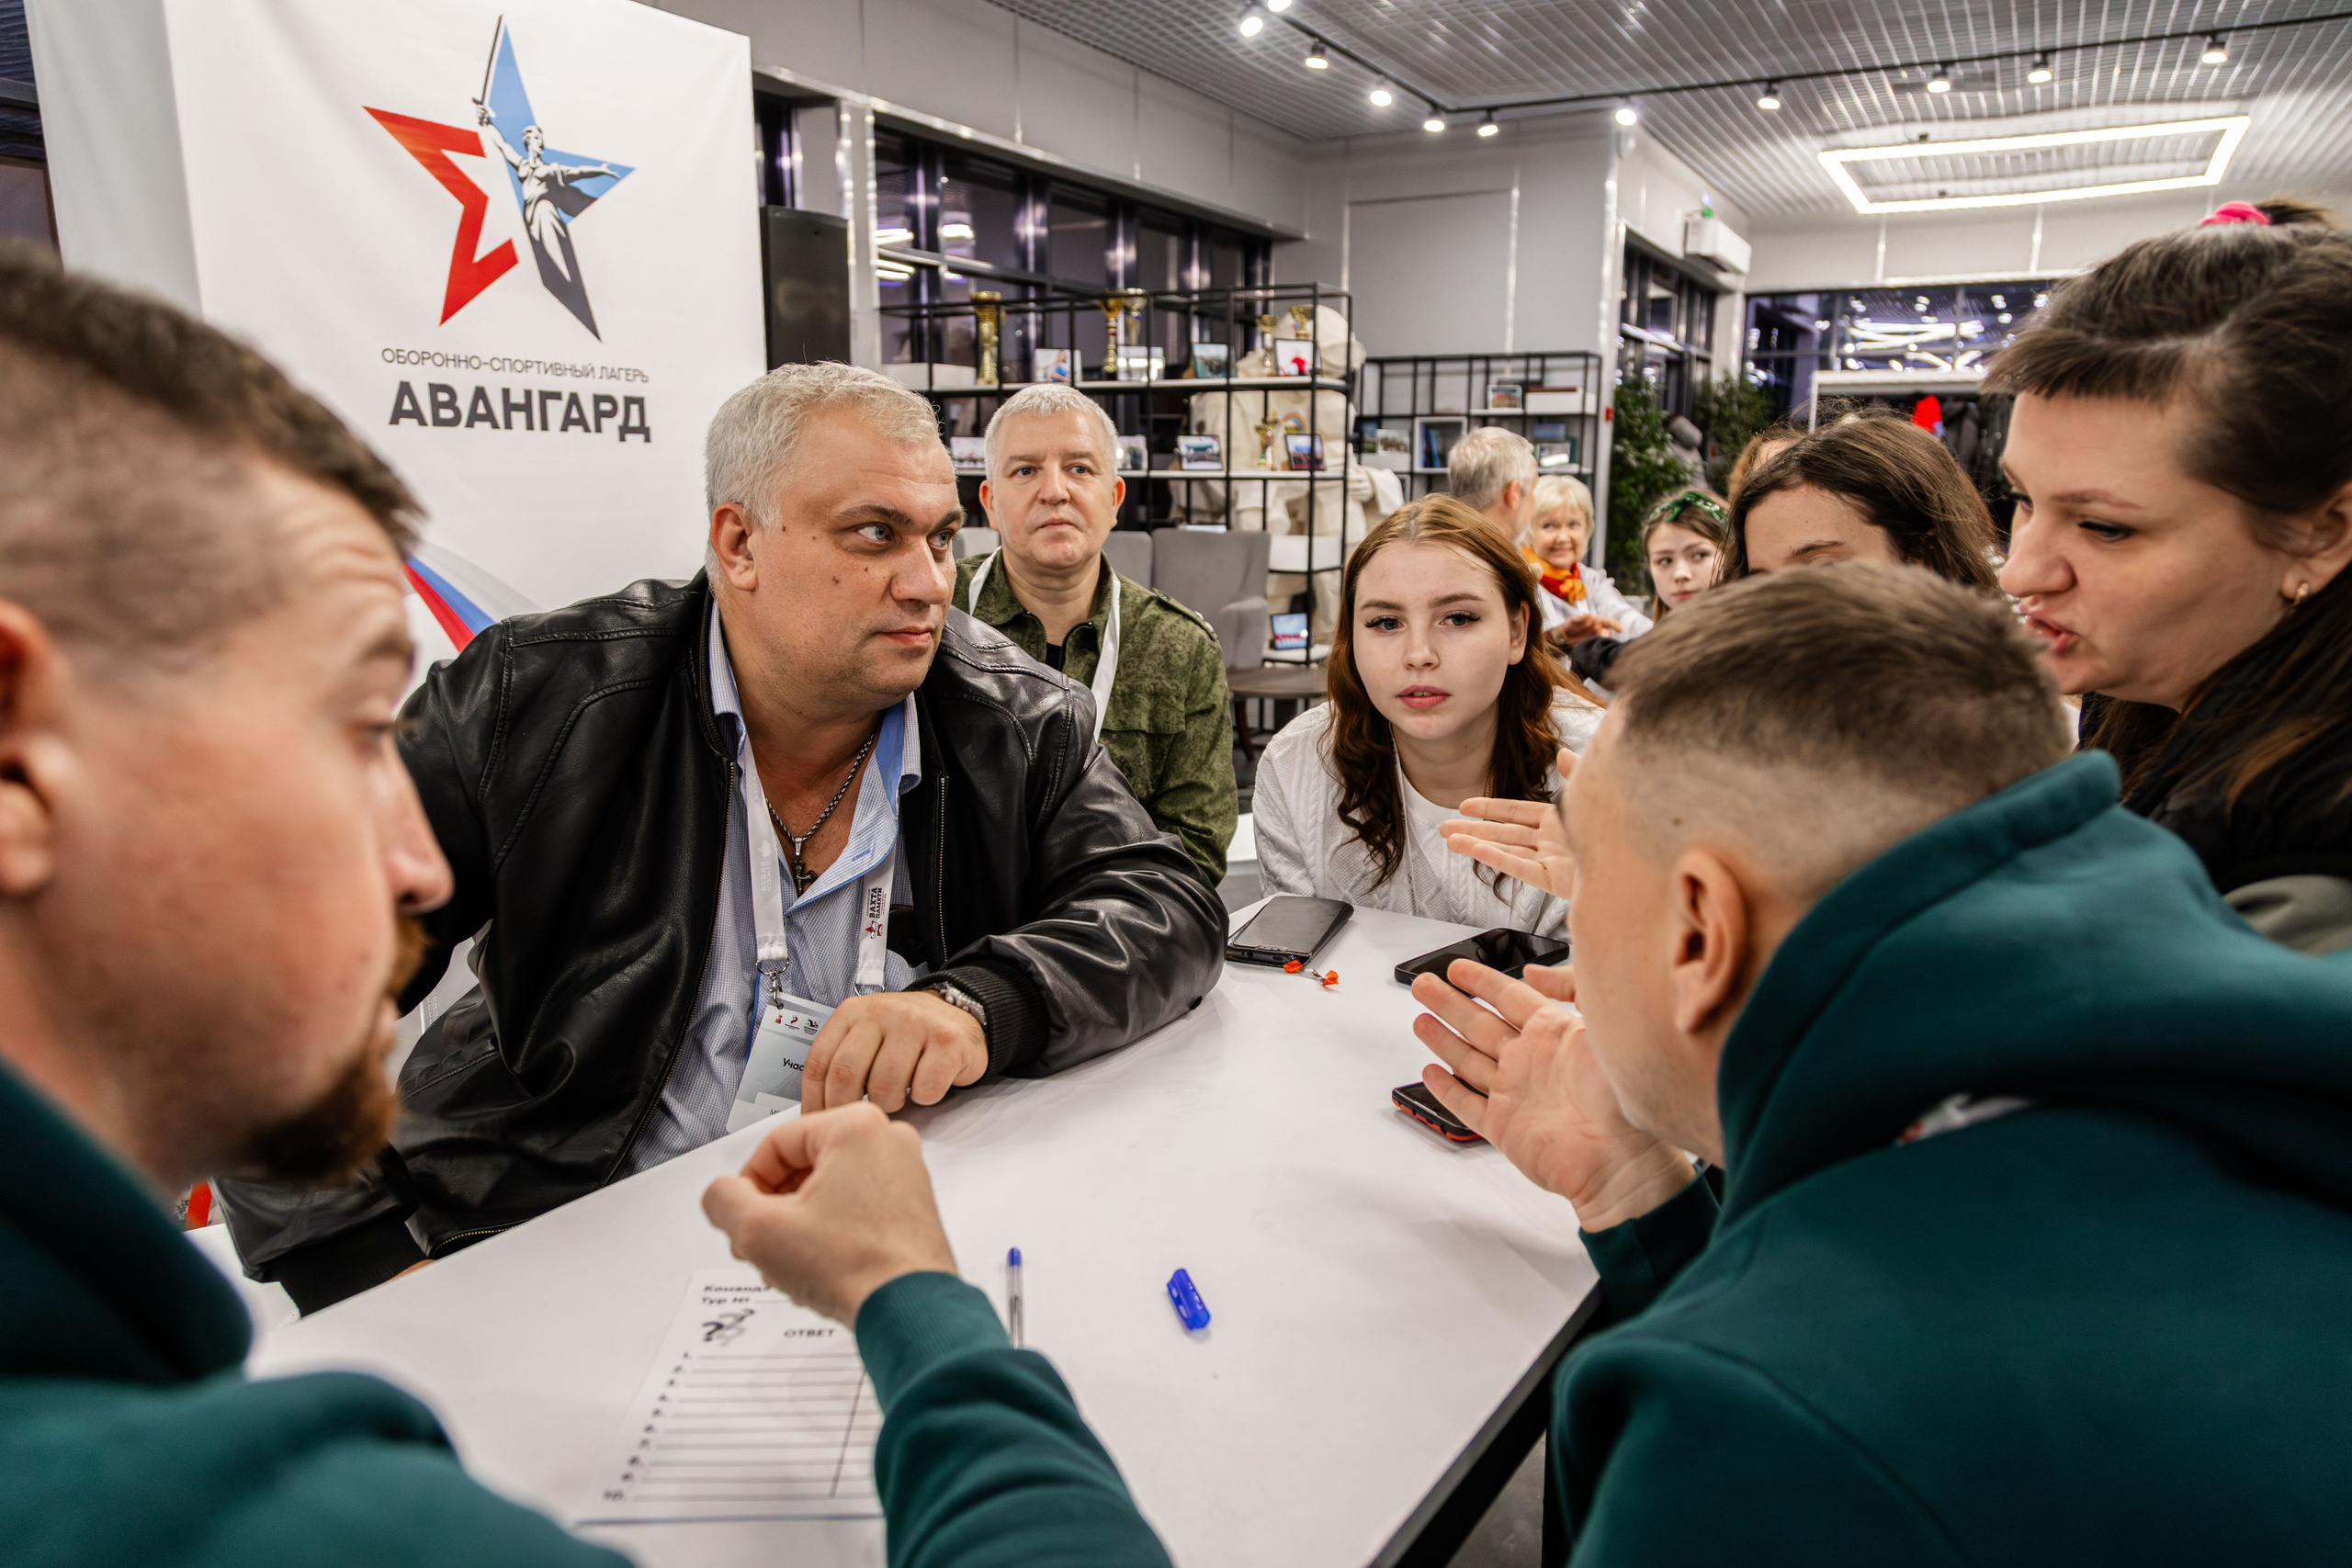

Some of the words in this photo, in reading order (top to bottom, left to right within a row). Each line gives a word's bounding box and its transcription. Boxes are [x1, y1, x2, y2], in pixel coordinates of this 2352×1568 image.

[381, 347, 595, 378] ОБОРОННО-СПОРТИВНЫЙ
[598, 365, 650, 384] ЛАГЕРЬ
[389, 380, 651, 444] АВАНГАРД
[869, 887, 877, 918] ВАХТА
[783, 1328, 836, 1338] ОТВЕТ
